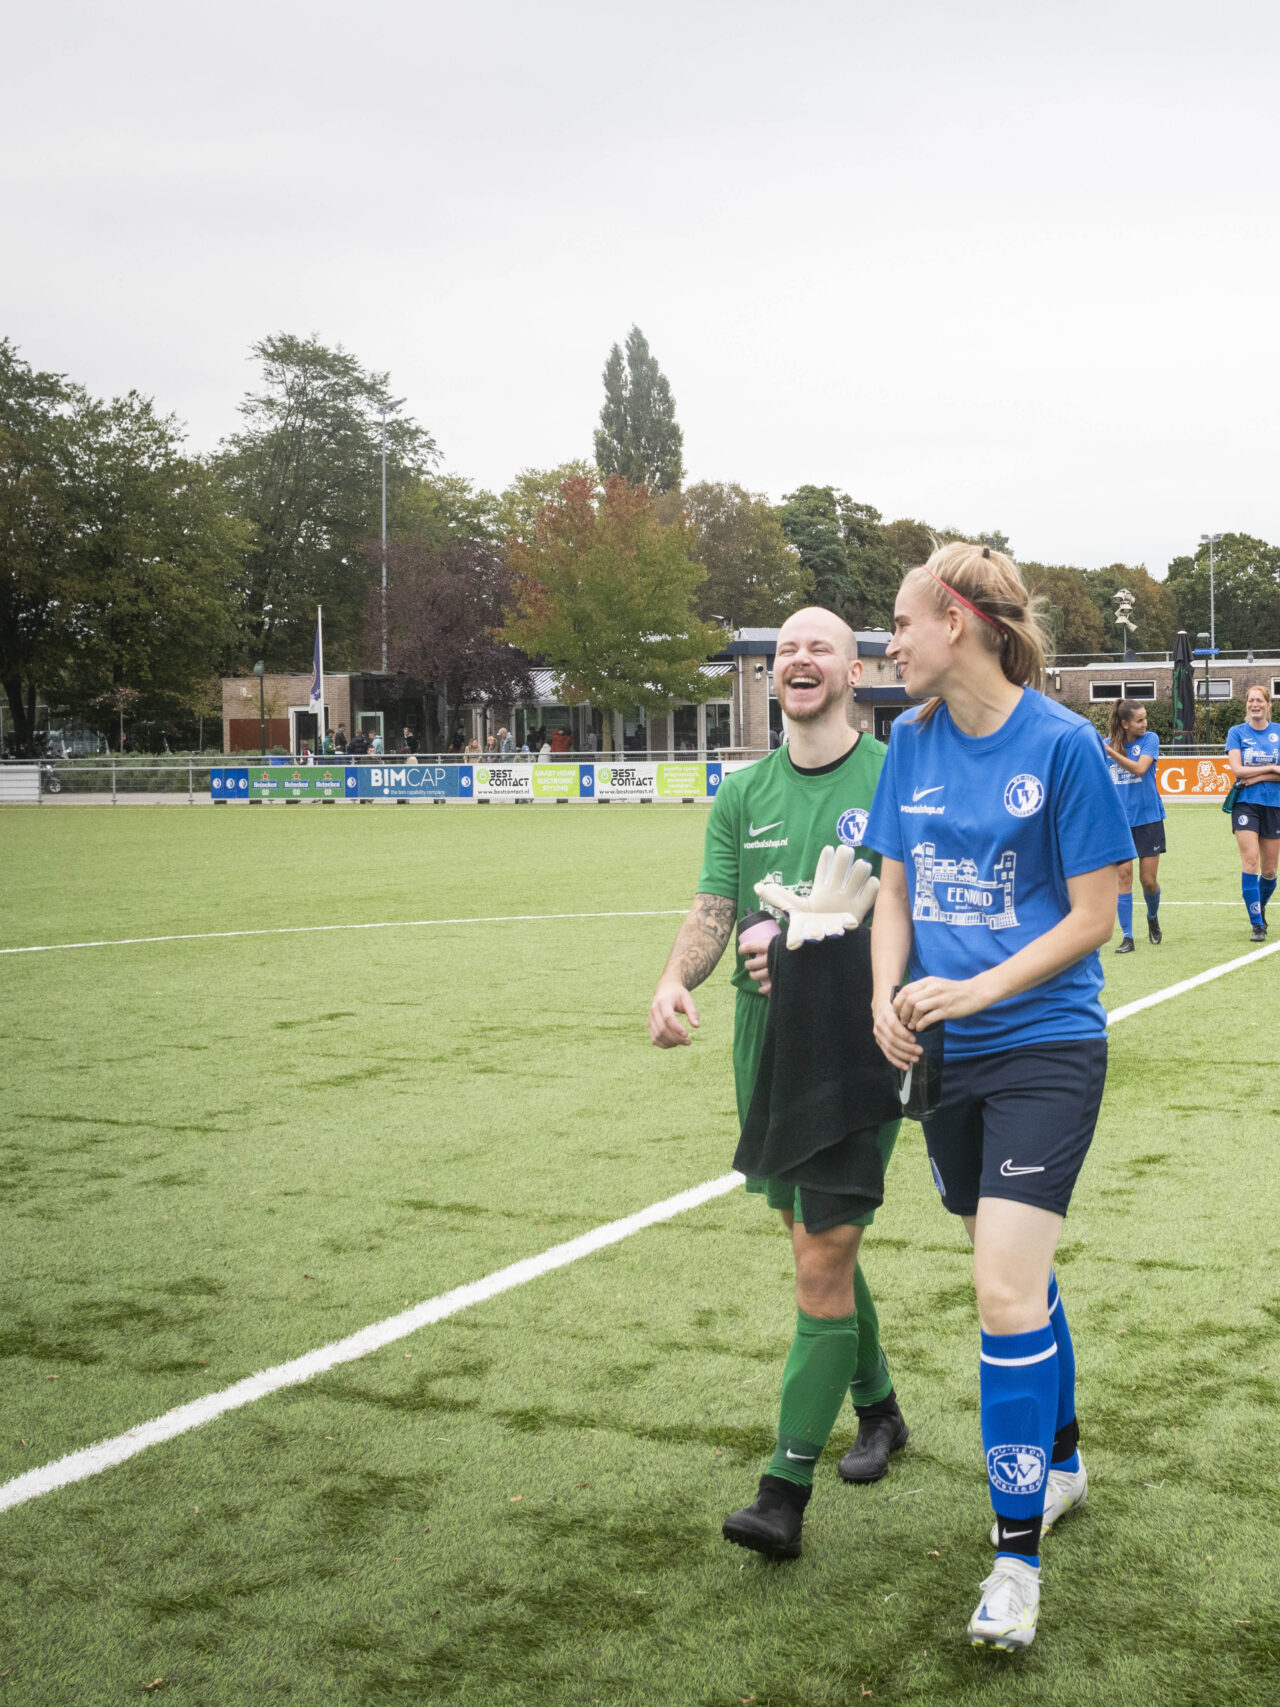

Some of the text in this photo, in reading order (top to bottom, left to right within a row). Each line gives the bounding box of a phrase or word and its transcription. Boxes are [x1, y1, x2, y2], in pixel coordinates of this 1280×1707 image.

[489, 769, 512, 778] BEST
[610, 768, 636, 777] BEST
[370, 768, 446, 787] BIMCAP
[610, 777, 653, 787] CONTACT
[489, 778, 529, 787] CONTACT
